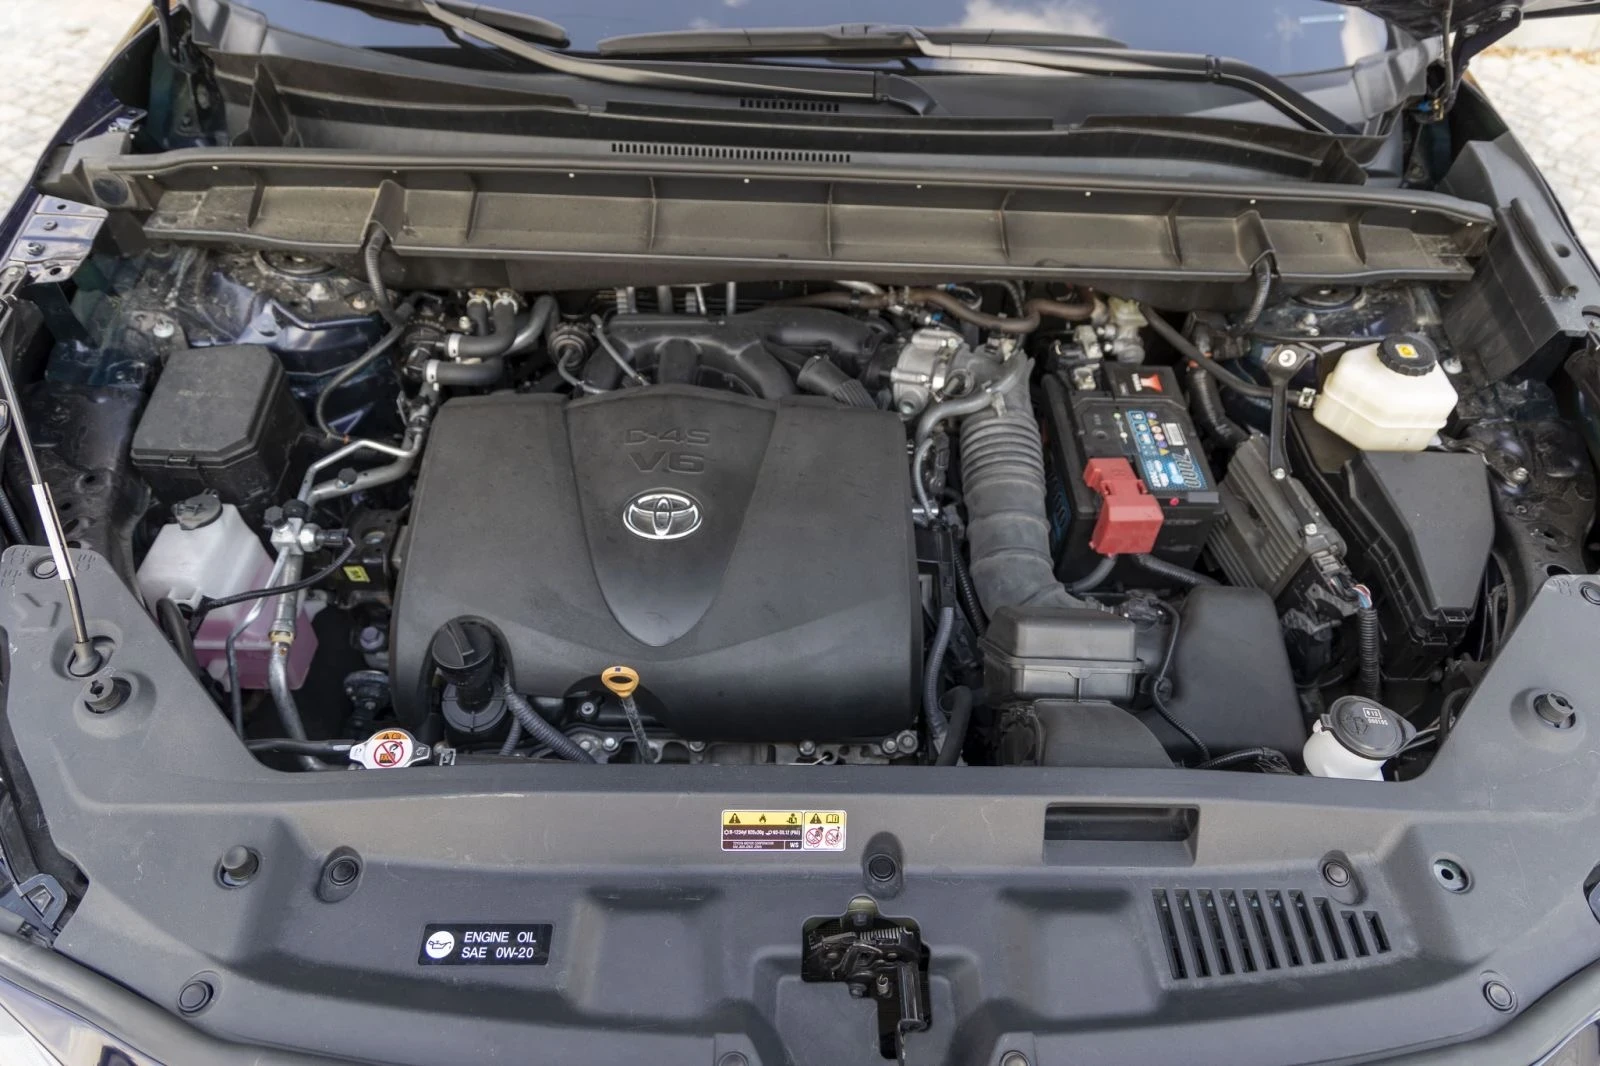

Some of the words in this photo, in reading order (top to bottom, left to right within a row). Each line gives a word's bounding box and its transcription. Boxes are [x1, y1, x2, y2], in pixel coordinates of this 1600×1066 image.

[623, 429, 711, 447] D-4S
[627, 450, 705, 475] V6
[463, 931, 510, 943] ENGINE
[516, 931, 537, 943] OIL
[461, 946, 488, 958] SAE
[495, 946, 535, 959] 0W-20
